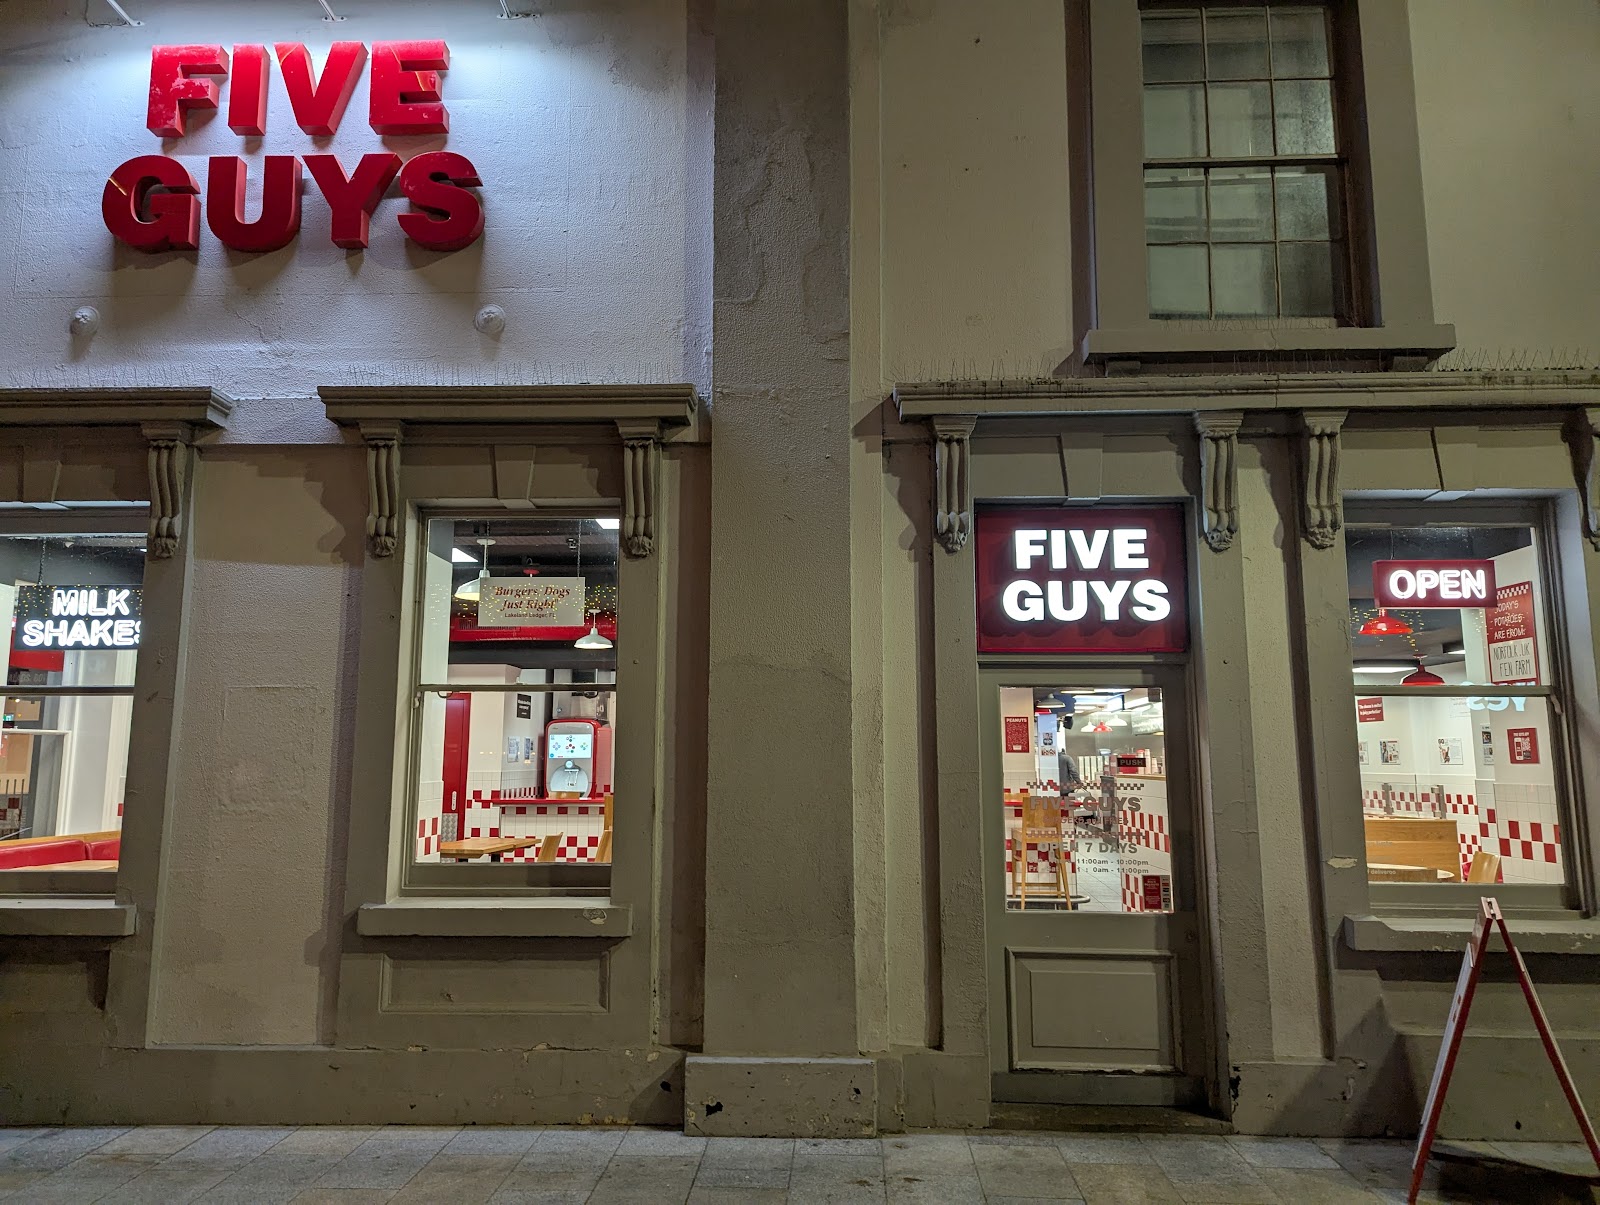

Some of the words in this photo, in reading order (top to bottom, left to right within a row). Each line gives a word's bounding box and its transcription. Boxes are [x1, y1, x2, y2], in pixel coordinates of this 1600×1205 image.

[146, 40, 450, 137] FIVE
[101, 151, 485, 252] GUYS
[1014, 528, 1149, 570] FIVE
[544, 586, 571, 598] Dogs
[1389, 569, 1487, 599] OPEN
[52, 589, 130, 616] MILK
[500, 599, 523, 611] Just
[1002, 579, 1171, 622] GUYS
[1494, 629, 1506, 640] ARE
[1515, 659, 1531, 675] FARM
[1119, 758, 1144, 766] PUSH
[1030, 796, 1076, 810] FIVE
[1083, 797, 1141, 811] GUYS
[1037, 842, 1078, 853] OPEN
[1085, 842, 1092, 853] 7
[1099, 842, 1138, 853] DAYS
